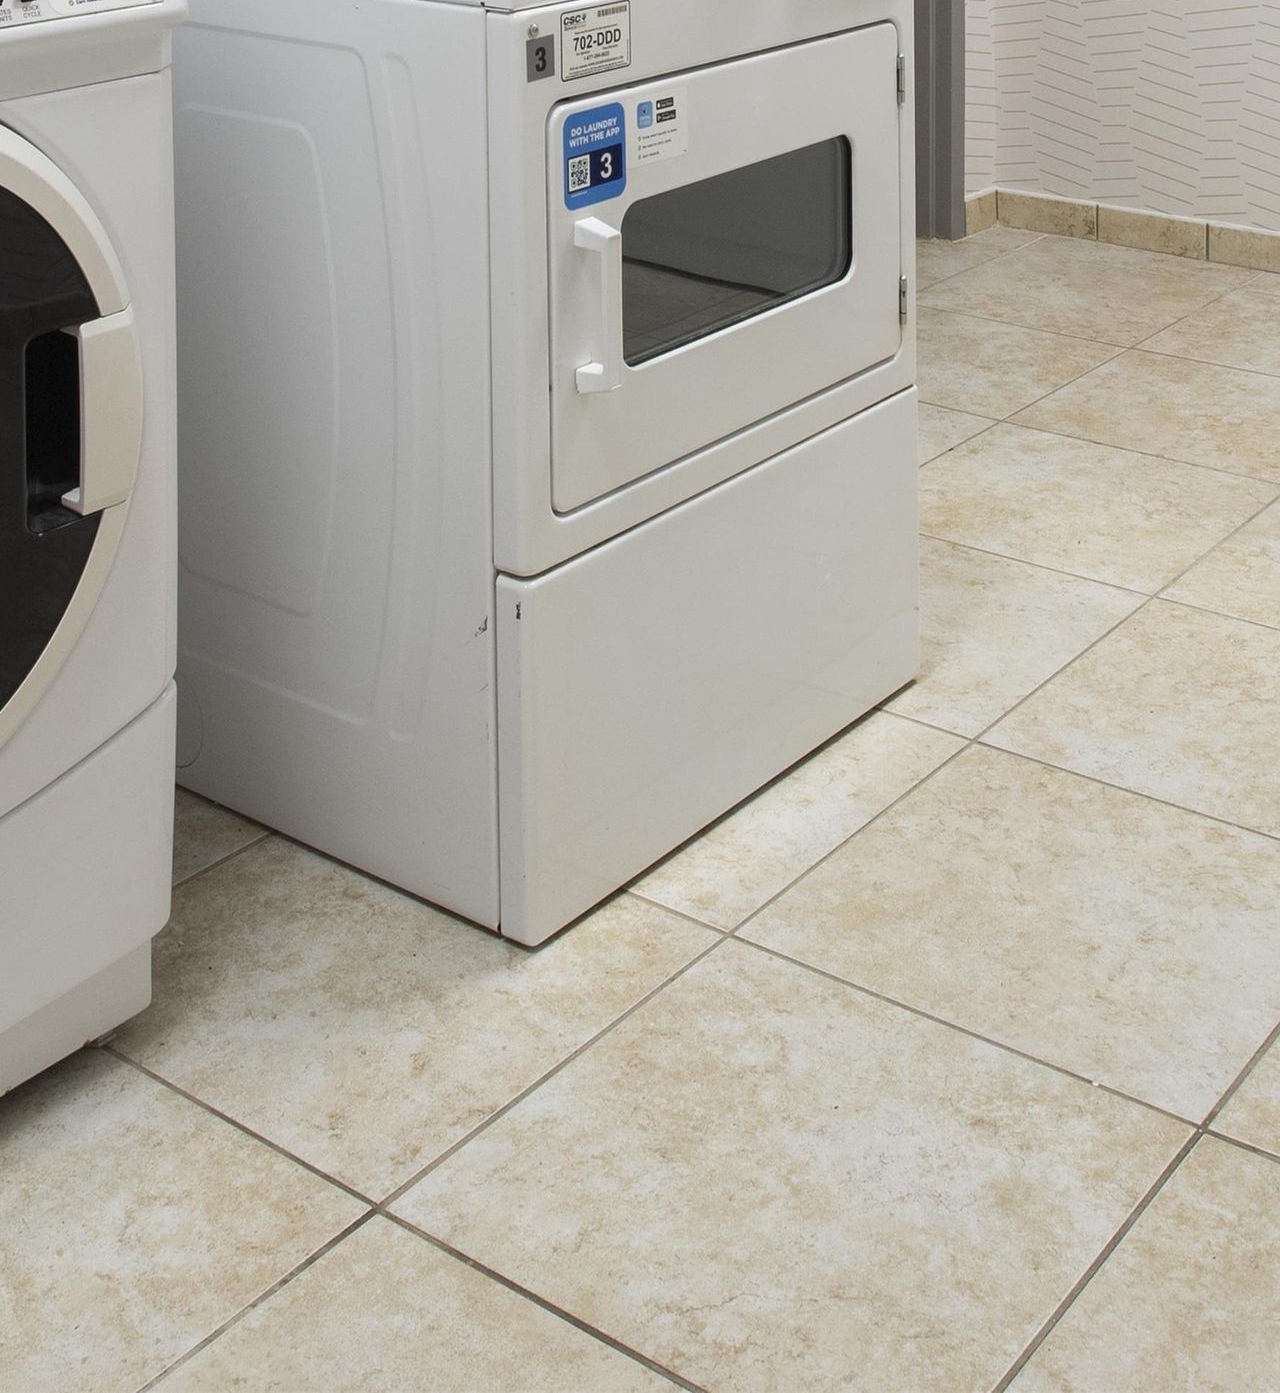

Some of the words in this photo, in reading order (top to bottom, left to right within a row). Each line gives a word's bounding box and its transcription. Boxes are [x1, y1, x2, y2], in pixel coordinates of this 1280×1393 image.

[22, 5, 40, 13] QUICK
[23, 11, 41, 19] CYCLE
[563, 14, 581, 26] CSC
[573, 28, 621, 52] 702-DDD
[534, 47, 547, 72] 3
[569, 135, 589, 148] WITH
[590, 131, 604, 142] THE
[605, 126, 620, 138] APP
[570, 126, 582, 137] DO
[583, 117, 618, 134] LAUNDRY
[600, 152, 612, 179] 3
